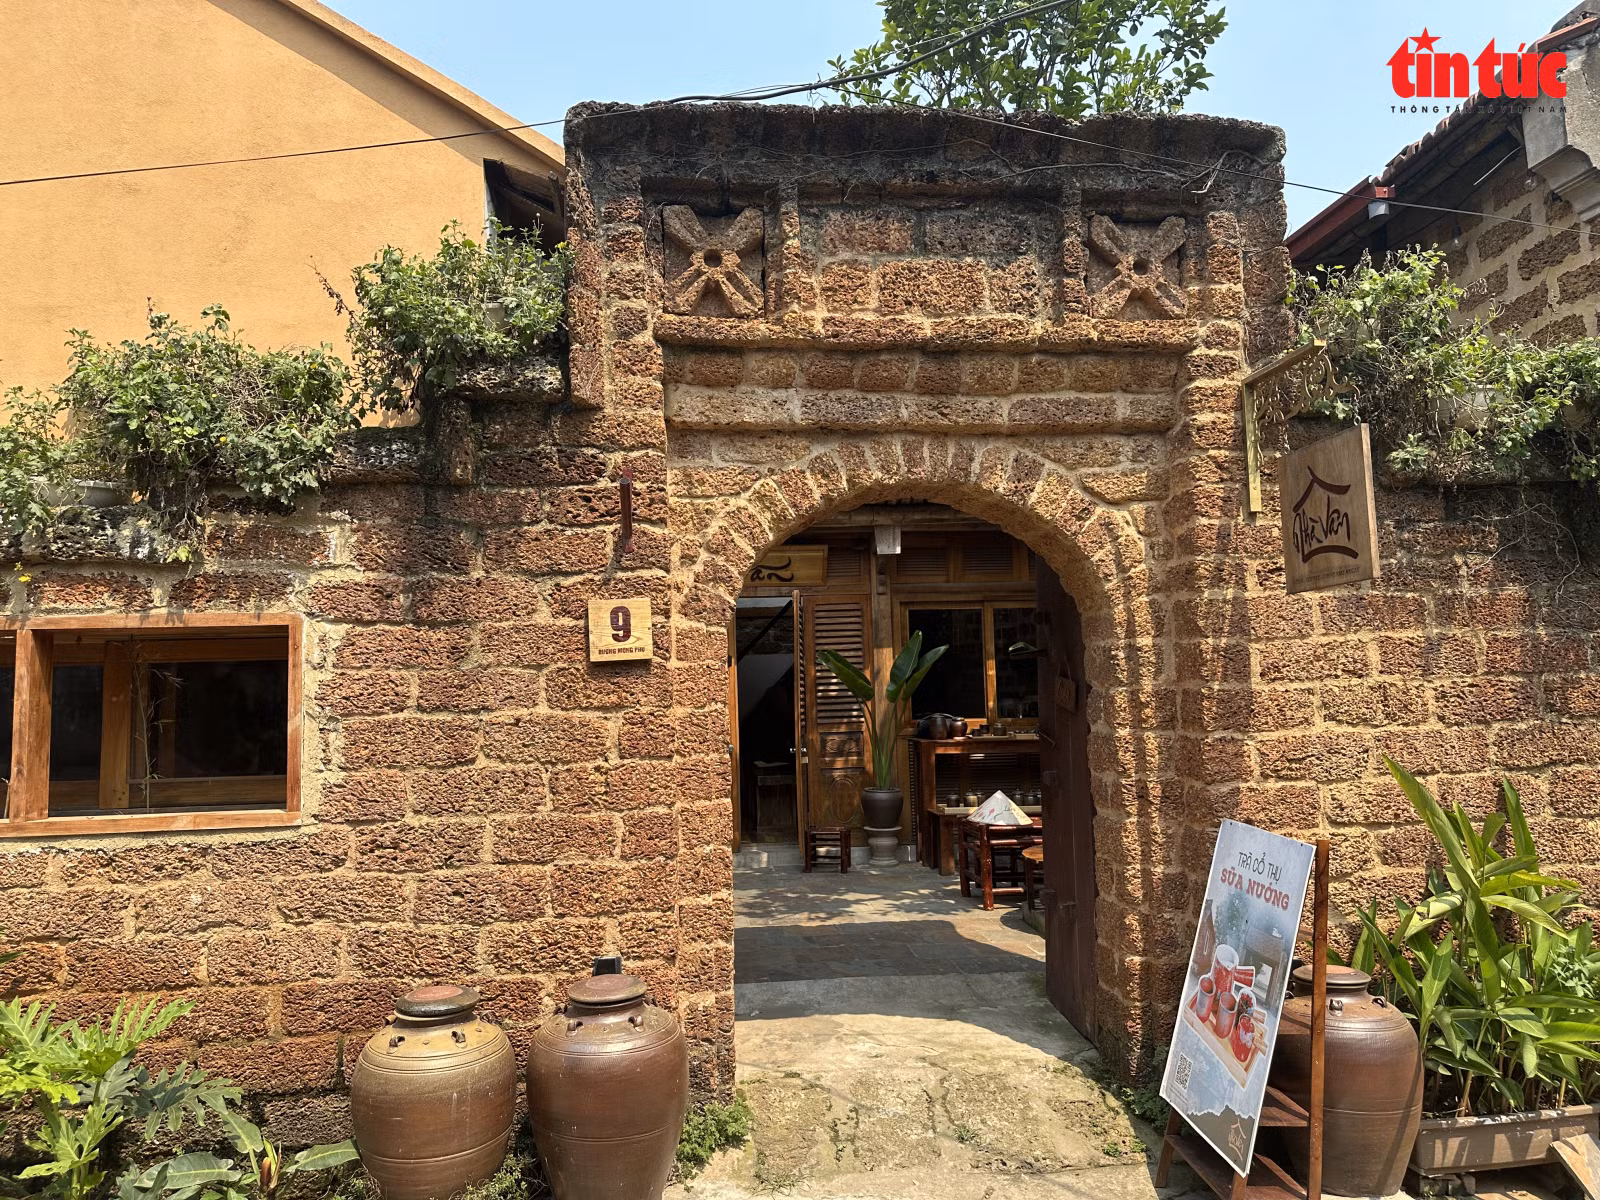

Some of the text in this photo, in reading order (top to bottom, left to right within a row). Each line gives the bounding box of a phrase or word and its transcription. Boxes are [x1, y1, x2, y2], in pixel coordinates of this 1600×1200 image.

[610, 606, 631, 642] 9
[1238, 852, 1282, 885] TRÀ CỔ THỤ
[1221, 866, 1290, 911] SỮA NƯỚNG
